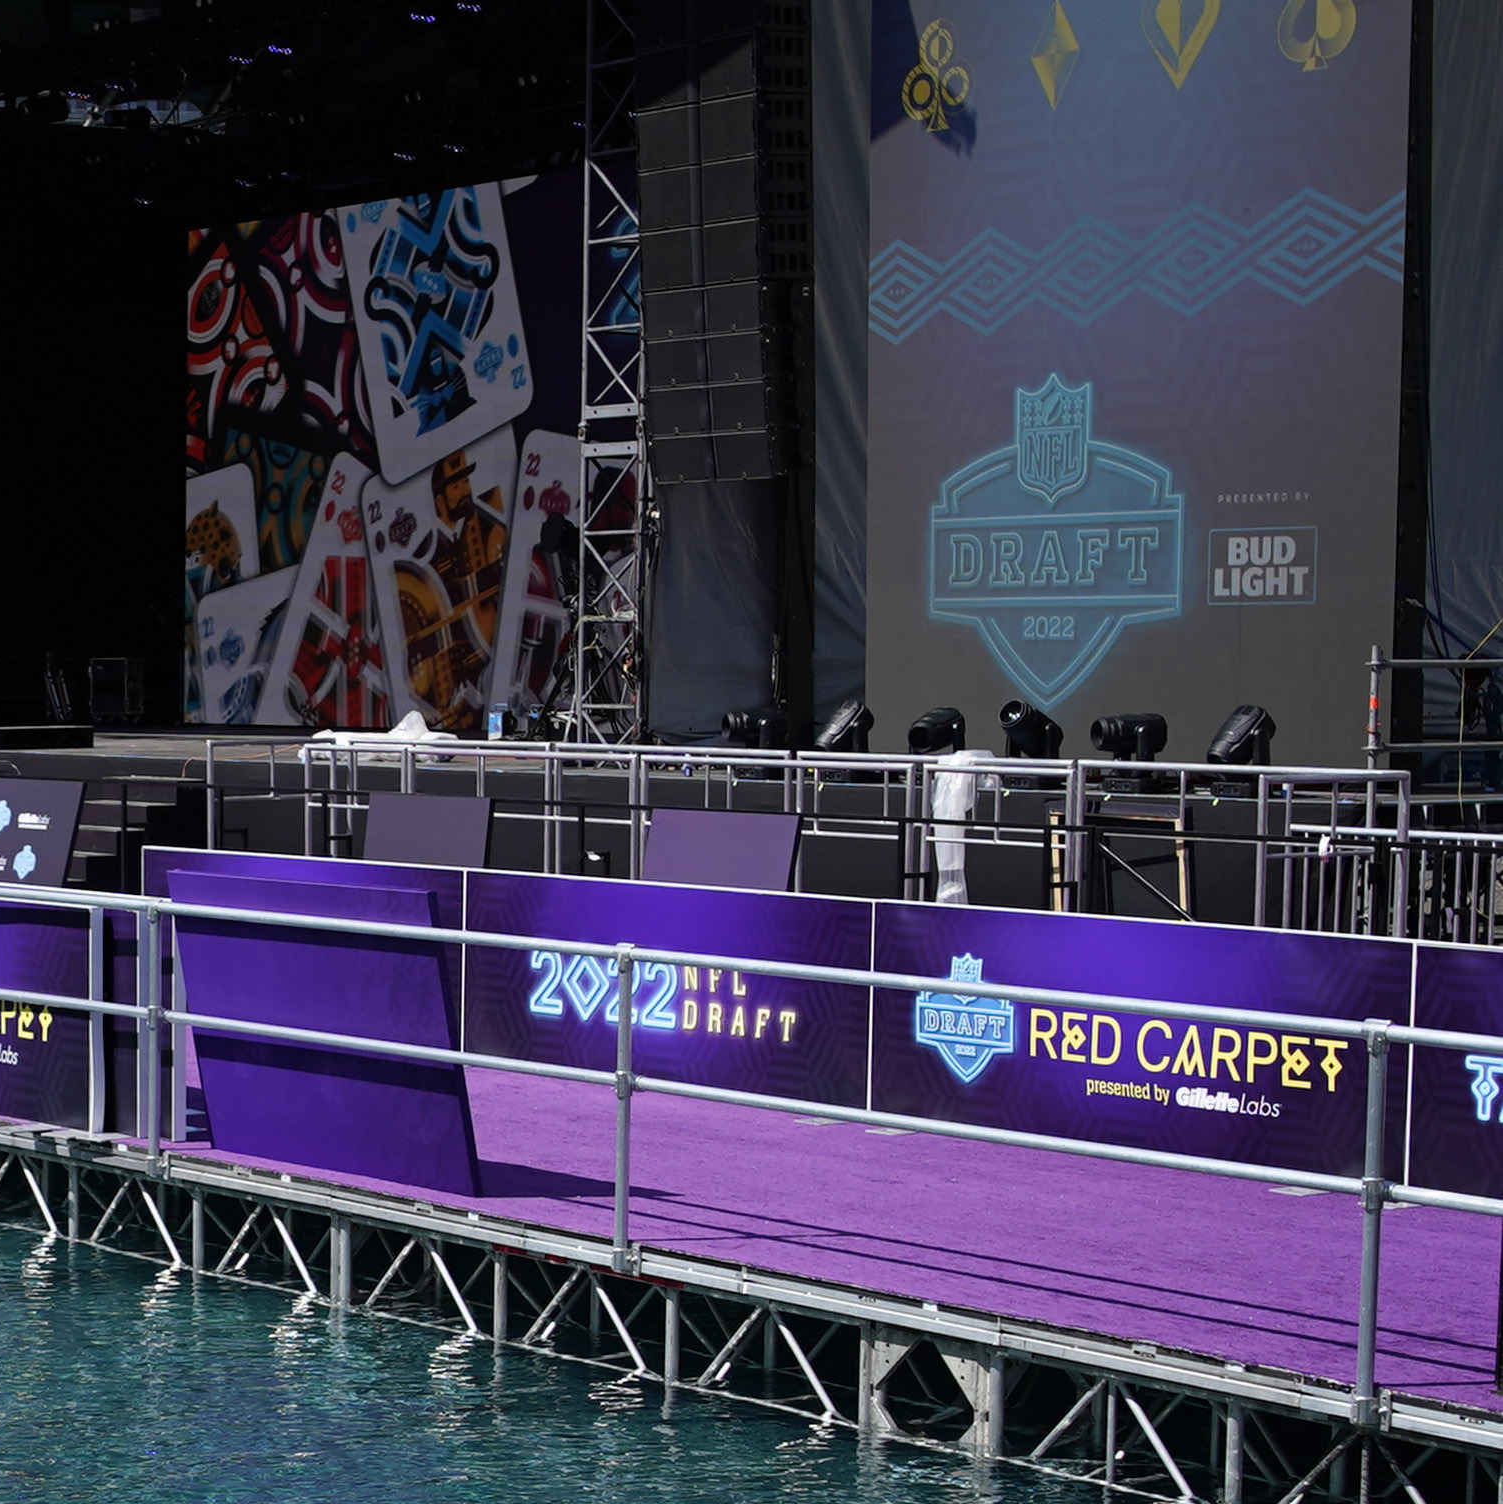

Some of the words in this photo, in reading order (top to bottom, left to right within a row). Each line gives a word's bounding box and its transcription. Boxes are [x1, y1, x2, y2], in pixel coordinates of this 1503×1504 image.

[1023, 430, 1080, 484] NFL
[1217, 491, 1288, 504] PRESENTED
[949, 525, 1160, 589] DRAFT
[1228, 536, 1297, 567] BUD
[1214, 565, 1309, 597] LIGHT
[1023, 614, 1076, 642] 2022
[528, 950, 678, 1030] 2022
[682, 965, 748, 996] NFL
[682, 999, 797, 1042] DRAFT
[923, 1009, 1006, 1039] DRAFT
[955, 1043, 977, 1057] 2022
[1029, 1008, 1122, 1066] RED
[1136, 1020, 1349, 1093] CARPET
[1086, 1077, 1152, 1101] presented
[1154, 1083, 1170, 1106] by
